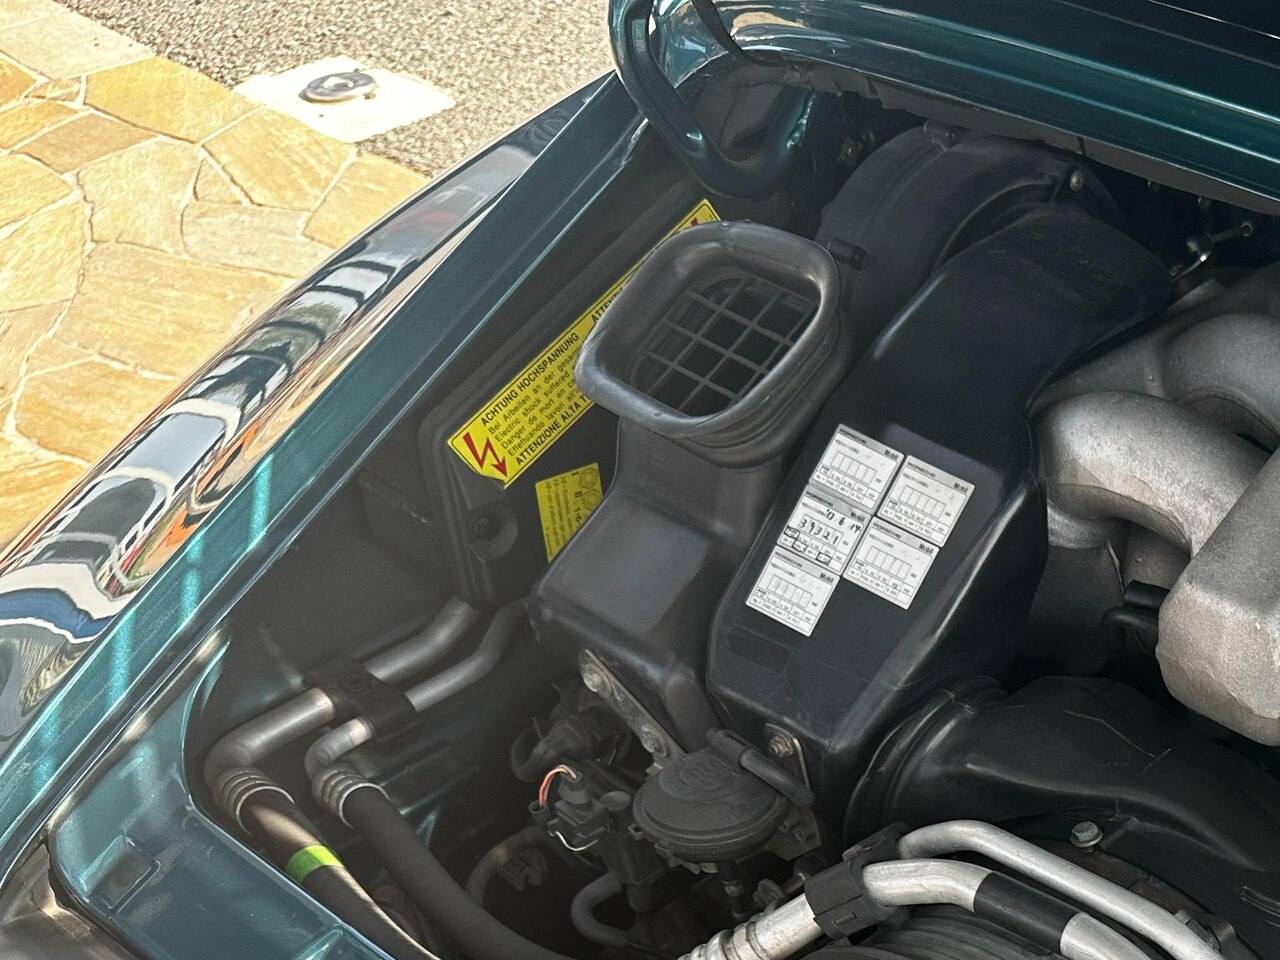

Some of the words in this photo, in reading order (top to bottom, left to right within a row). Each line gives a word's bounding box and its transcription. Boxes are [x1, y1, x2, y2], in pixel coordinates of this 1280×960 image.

[481, 390, 518, 426] ACHTUNG
[517, 332, 579, 392] HOCHSPANNUNG
[488, 423, 502, 435] Bei
[503, 395, 530, 421] Arbeiten
[533, 384, 542, 394] an
[544, 372, 555, 384] der
[495, 418, 521, 442] Electric
[523, 398, 542, 418] shock
[544, 372, 570, 398] suffered
[501, 426, 526, 449] Danger
[528, 415, 538, 425] de
[539, 398, 555, 414] mort
[557, 389, 566, 399] en
[507, 422, 545, 457] Effettuando
[546, 403, 565, 421] lavori
[516, 421, 562, 465] ATTENZIONE
[561, 402, 581, 422] ALTA
